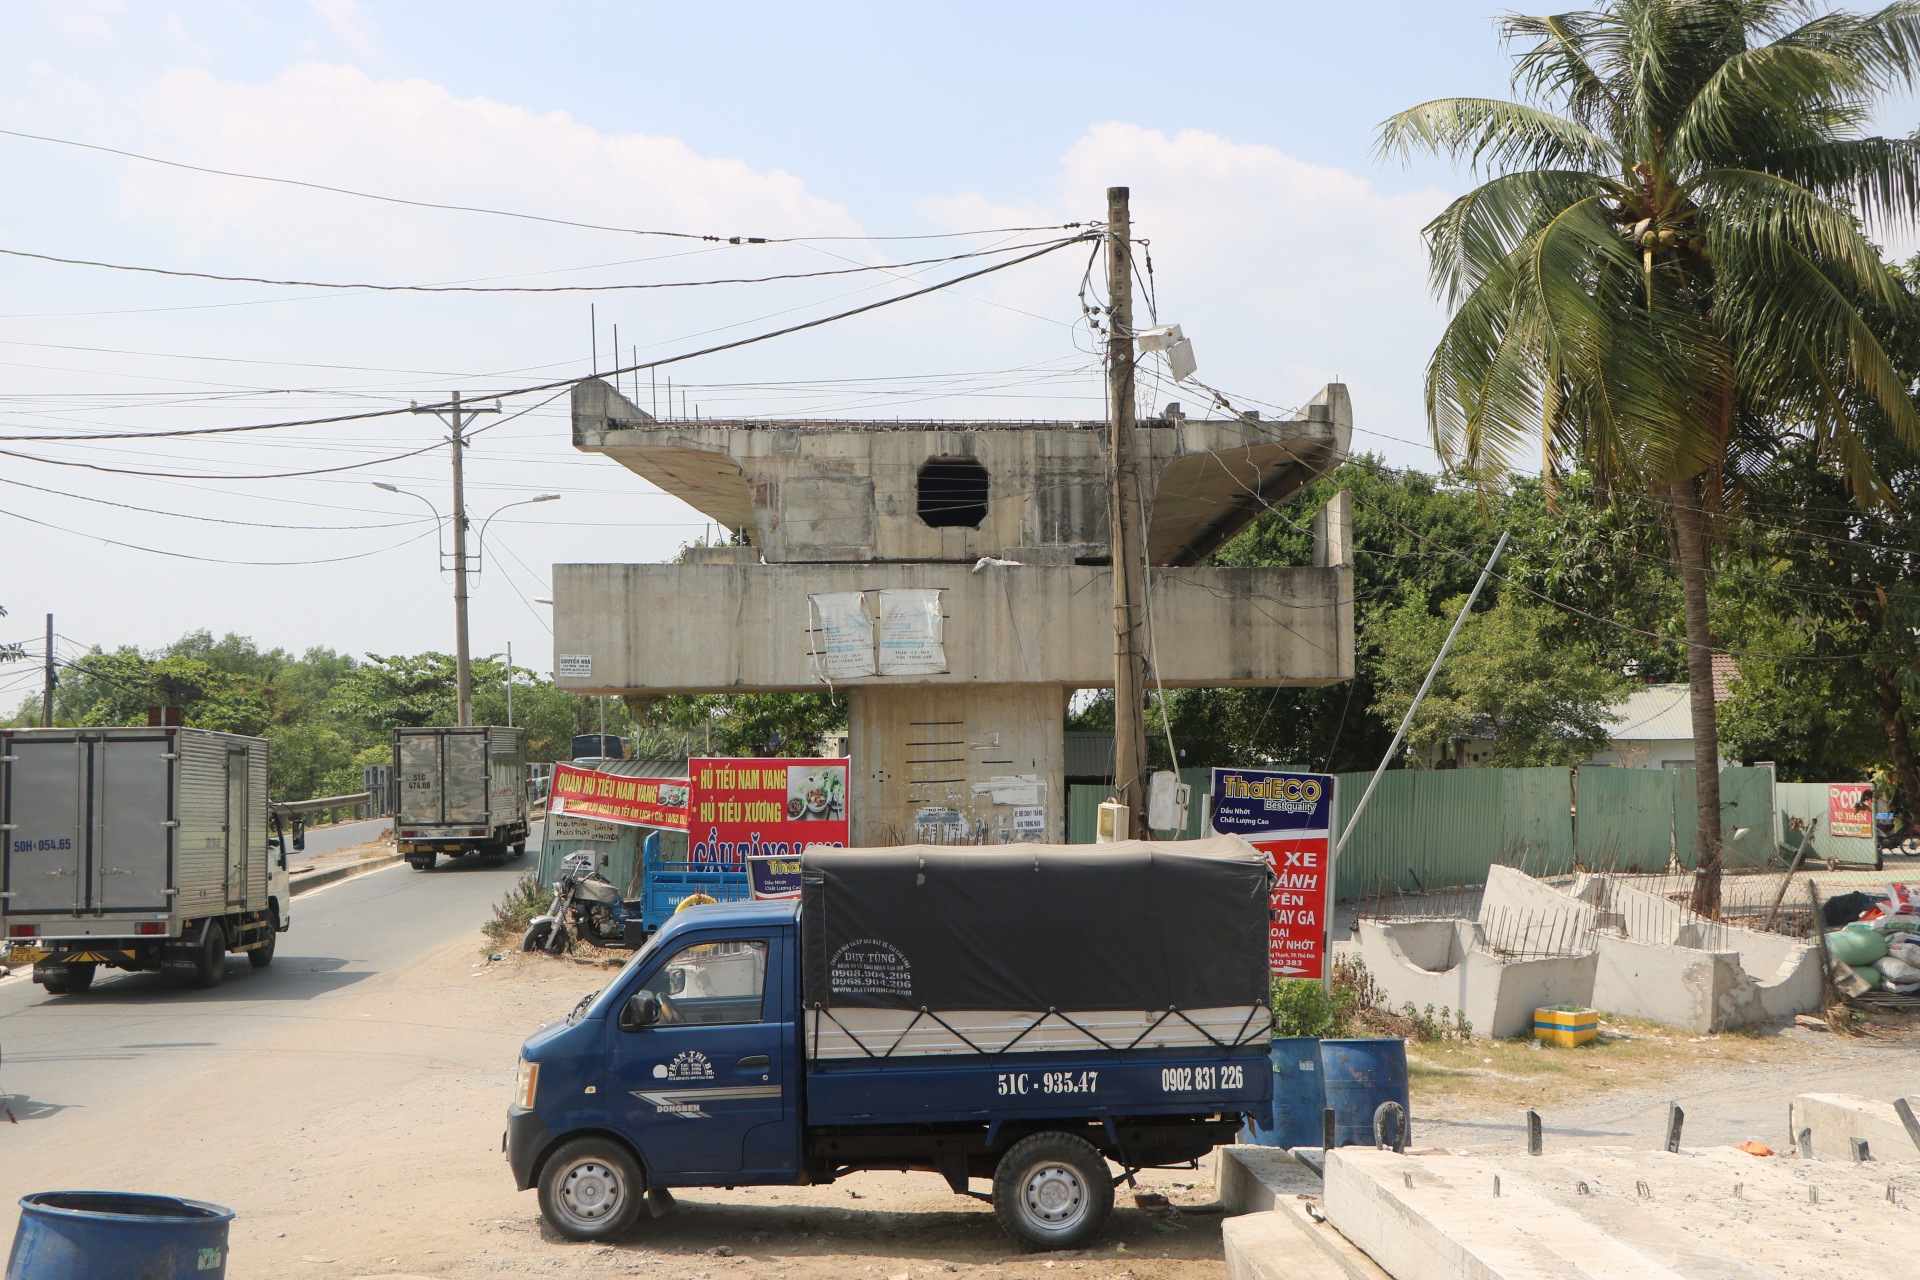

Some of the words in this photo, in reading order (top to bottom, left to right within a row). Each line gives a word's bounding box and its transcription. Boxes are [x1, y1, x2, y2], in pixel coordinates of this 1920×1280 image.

[700, 763, 713, 789] HỦ
[716, 763, 736, 789] TIẾU
[738, 769, 760, 789] NAM
[762, 769, 787, 789] VANG
[557, 771, 583, 793] QUÁN
[582, 772, 596, 795] HỦ
[597, 776, 616, 798] TIẾU
[615, 780, 636, 801] NAM
[637, 783, 658, 804] VANG
[1224, 775, 1322, 802] ThaiECO
[597, 802, 613, 815] NGÀY
[639, 809, 651, 822] LỊCH
[700, 795, 715, 823] HỦ
[718, 796, 741, 823] TIẾU
[744, 800, 781, 823] XƯƠNG
[1234, 807, 1251, 815] Nhớt
[1264, 799, 1286, 811] Best
[1286, 801, 1318, 815] quality
[1219, 816, 1236, 824] Chất
[1235, 817, 1256, 826] Lượng
[14, 840, 33, 853] 50H
[38, 838, 71, 851] 054.65
[693, 827, 734, 873] CẦU
[1283, 851, 1318, 868] XE
[1277, 909, 1296, 925] AY
[1297, 909, 1316, 926] GA
[1269, 927, 1290, 940] OẠI
[16, 947, 31, 955] 50H
[1269, 939, 1285, 949] AY
[1286, 938, 1316, 951] NHỚT
[9, 954, 36, 963] 054.65
[844, 952, 865, 962] DUY
[867, 950, 896, 964] TÙNG
[831, 969, 911, 980] 0908.904.206
[831, 977, 912, 989] 0968.904.206
[668, 1051, 687, 1078] PHAN
[998, 1073, 1029, 1096] 51C
[1043, 1071, 1099, 1094] 935.47
[1162, 1068, 1192, 1092] 0902
[1194, 1066, 1216, 1091] 831
[1220, 1065, 1244, 1090] 226
[656, 1104, 700, 1113] DONGBEN
